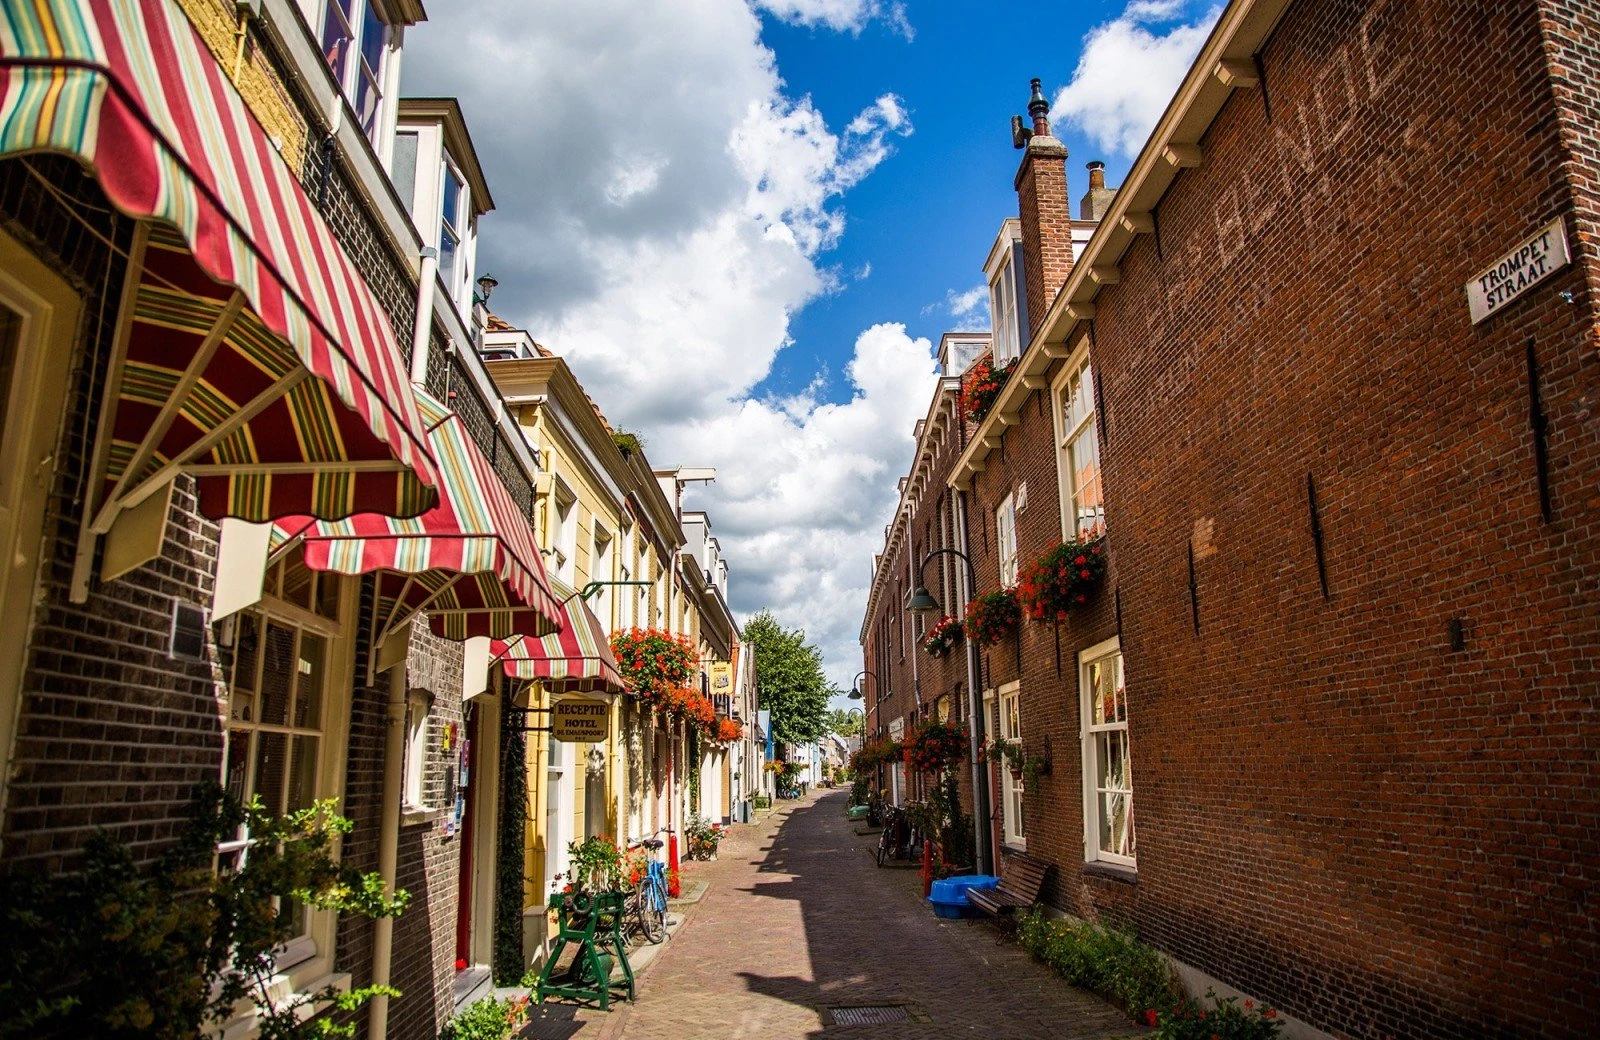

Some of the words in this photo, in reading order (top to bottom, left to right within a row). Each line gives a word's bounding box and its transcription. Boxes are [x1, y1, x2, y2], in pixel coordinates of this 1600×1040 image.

[1478, 231, 1550, 294] TROMPET
[557, 704, 605, 715] RECEPTIE
[564, 719, 597, 728] HOTEL
